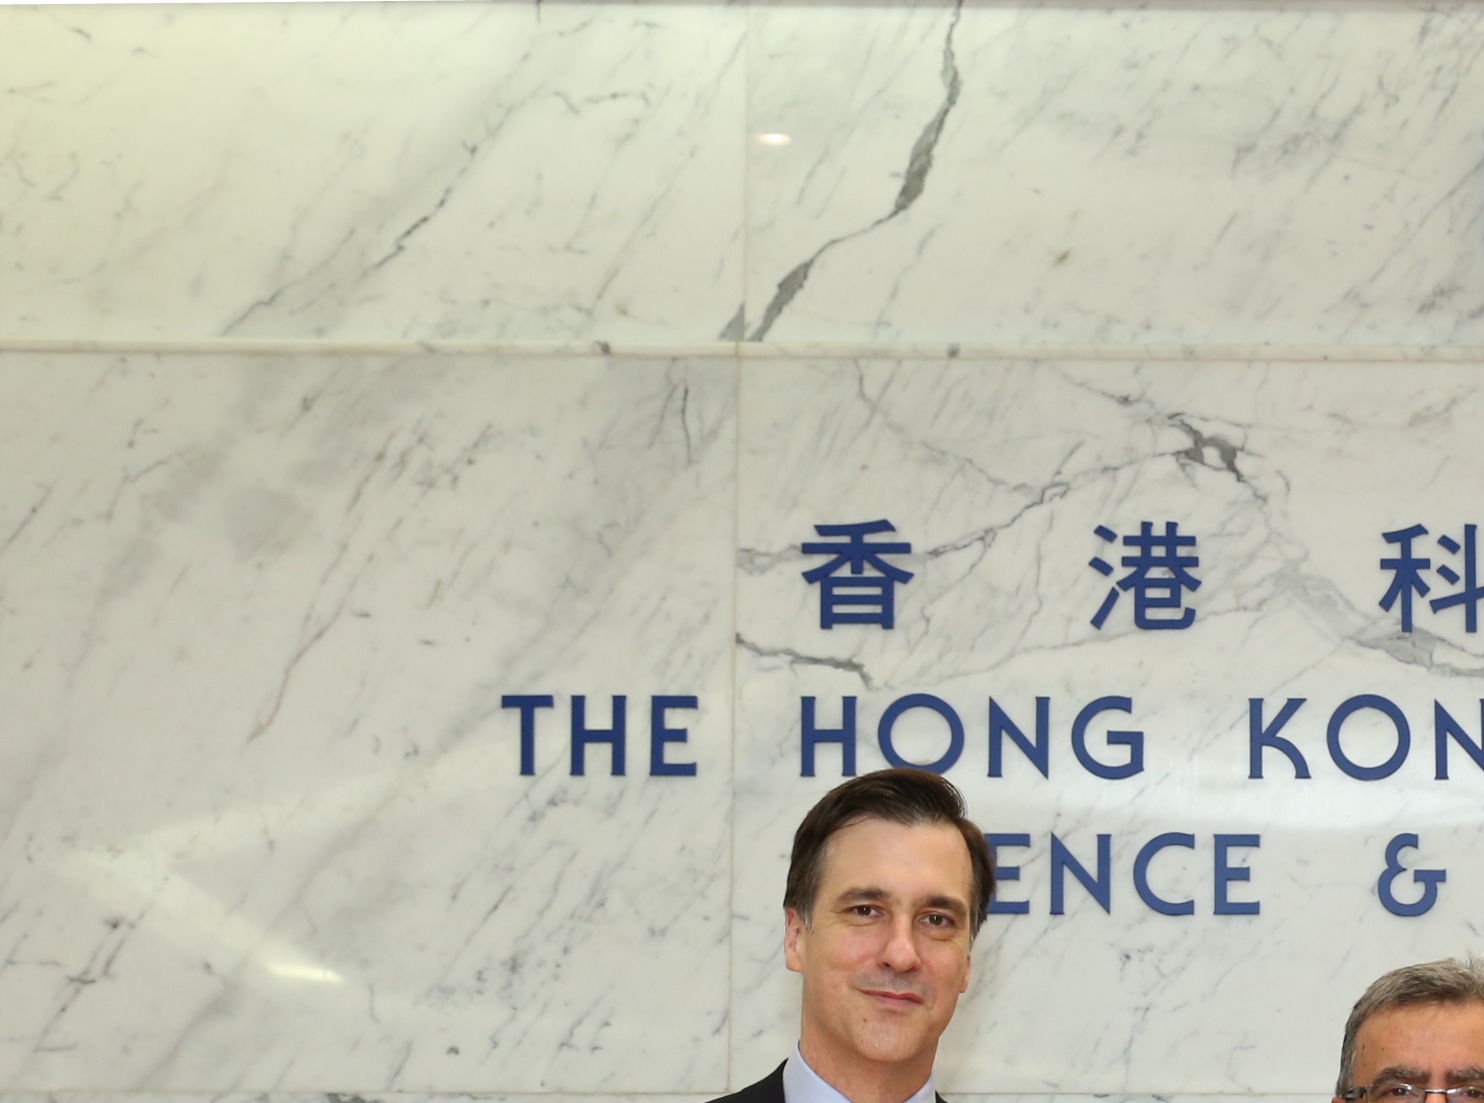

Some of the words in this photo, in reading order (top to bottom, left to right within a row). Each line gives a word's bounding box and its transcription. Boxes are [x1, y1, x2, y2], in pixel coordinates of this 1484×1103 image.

[502, 694, 698, 777] THE
[800, 692, 1144, 779] HONG
[985, 832, 1260, 916] ENCE
[1377, 832, 1447, 918] &
